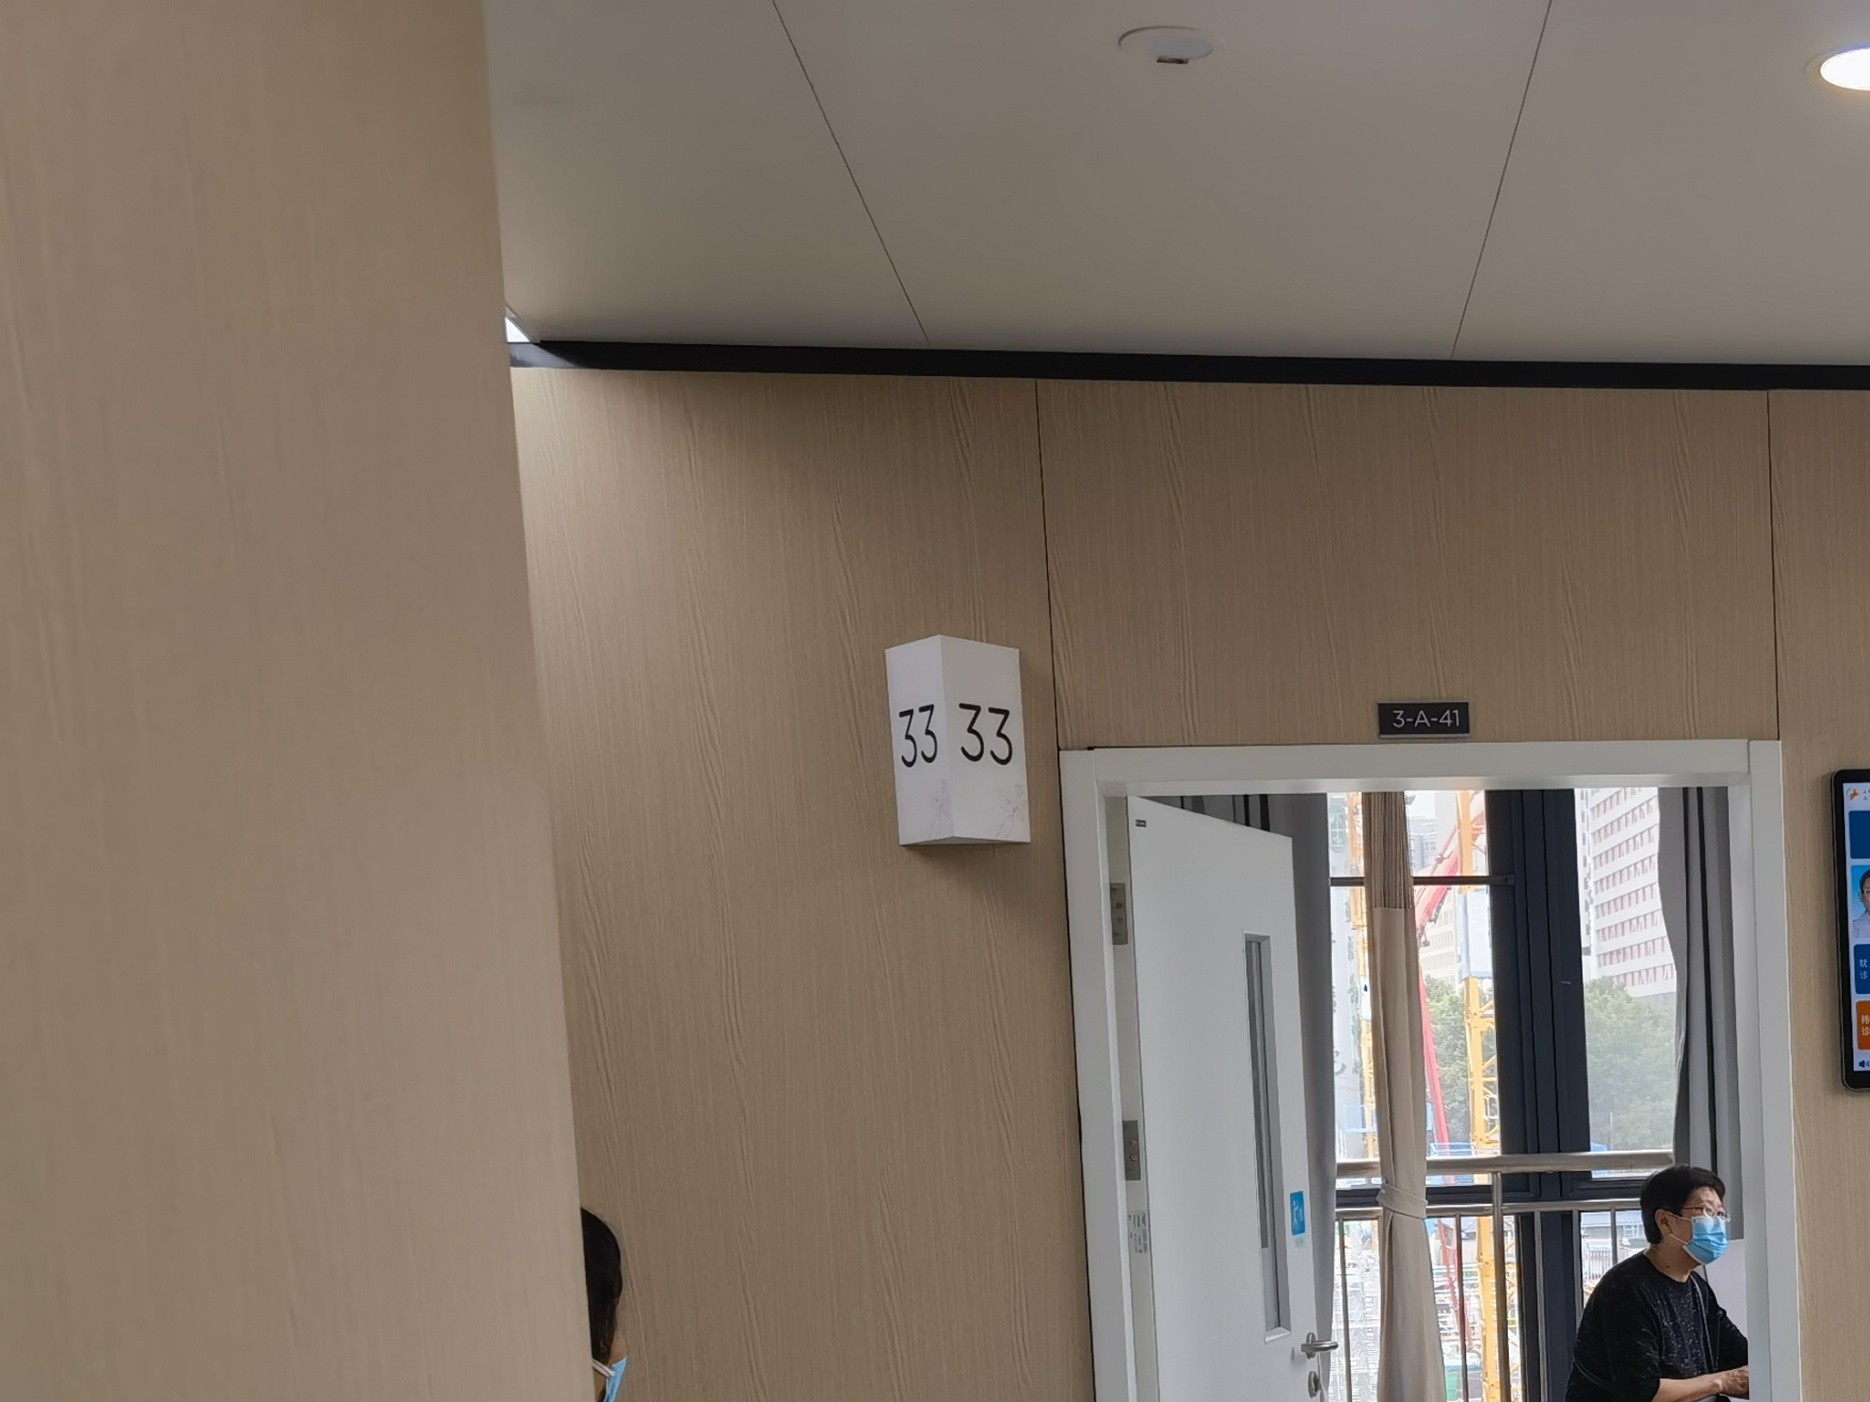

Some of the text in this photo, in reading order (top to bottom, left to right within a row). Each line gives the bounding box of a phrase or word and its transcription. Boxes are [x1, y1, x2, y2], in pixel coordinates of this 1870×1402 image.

[899, 704, 938, 767] 33
[958, 703, 1013, 766] 33
[1392, 709, 1460, 728] 3-A-41
